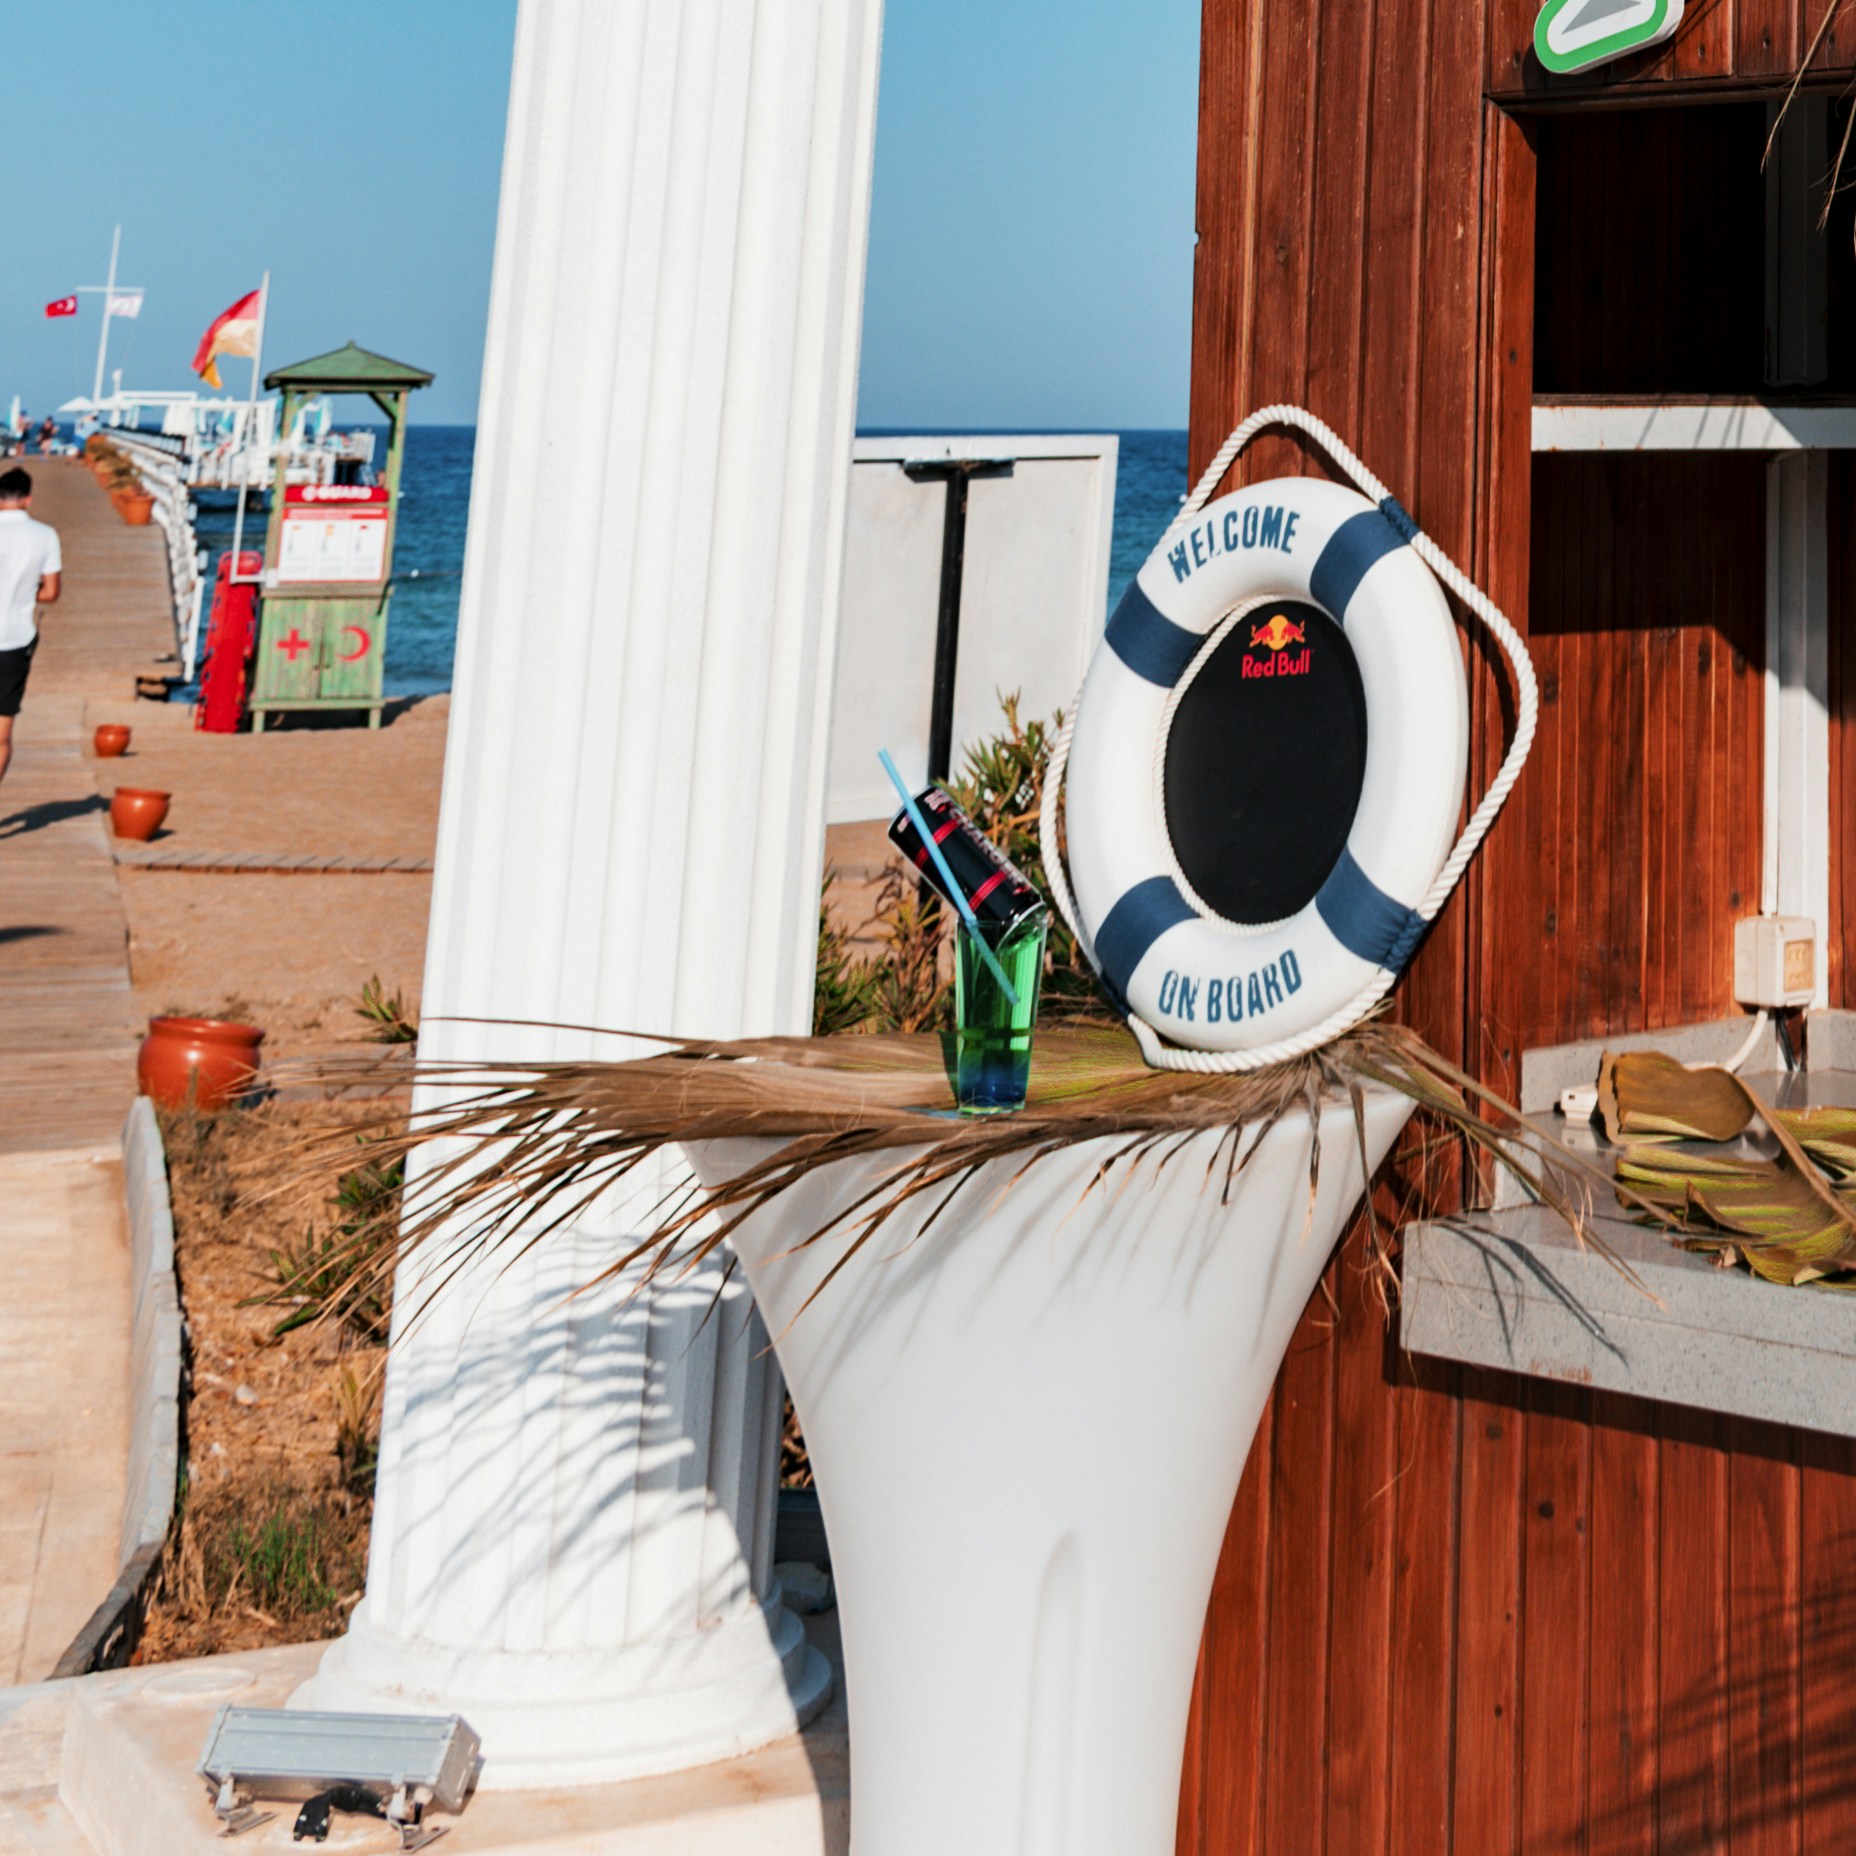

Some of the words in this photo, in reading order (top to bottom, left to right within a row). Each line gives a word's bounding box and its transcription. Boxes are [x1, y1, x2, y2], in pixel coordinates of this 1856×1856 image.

[1167, 504, 1300, 583] WELCOME
[1241, 652, 1276, 679] Red
[1277, 648, 1311, 676] Bull
[1158, 969, 1198, 1021] ON
[1206, 948, 1302, 1024] BOARD
